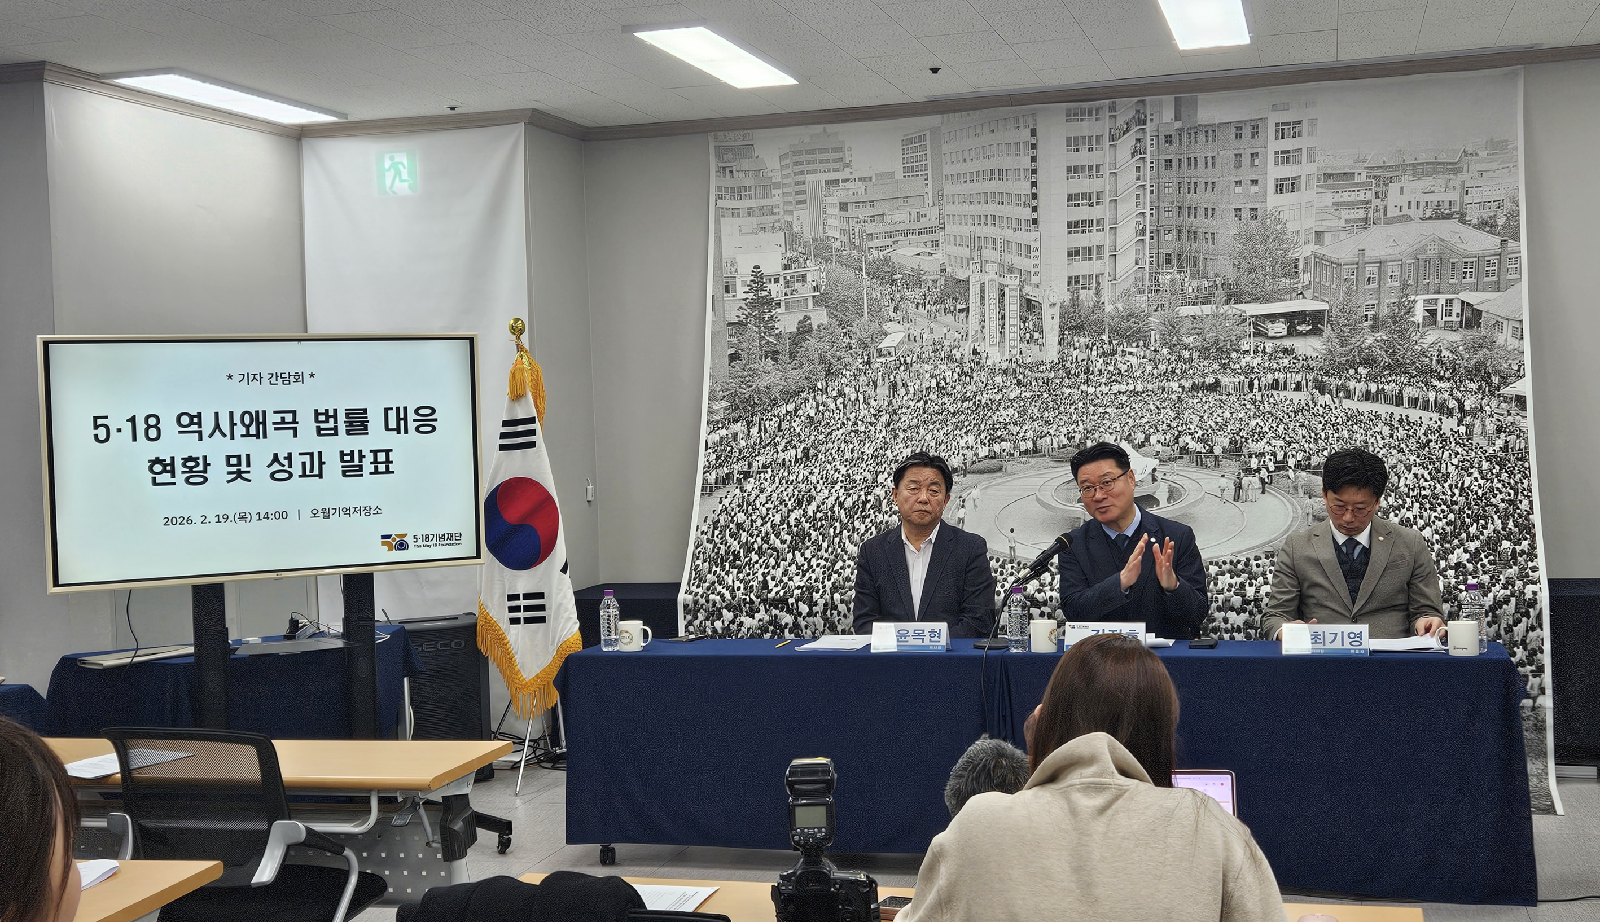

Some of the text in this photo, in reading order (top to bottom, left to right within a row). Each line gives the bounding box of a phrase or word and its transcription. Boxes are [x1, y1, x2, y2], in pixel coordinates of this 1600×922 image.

[238, 371, 305, 386] 기자 간담회
[92, 405, 438, 444] 5·18 역사왜곡 법률 대응
[147, 448, 395, 487] 현황 및 성과 발표
[162, 505, 383, 526] 2026. 2. 19.(목) 14:00 오월기억저장소
[896, 628, 942, 644] 윤목현
[1311, 630, 1363, 647] 최기영
